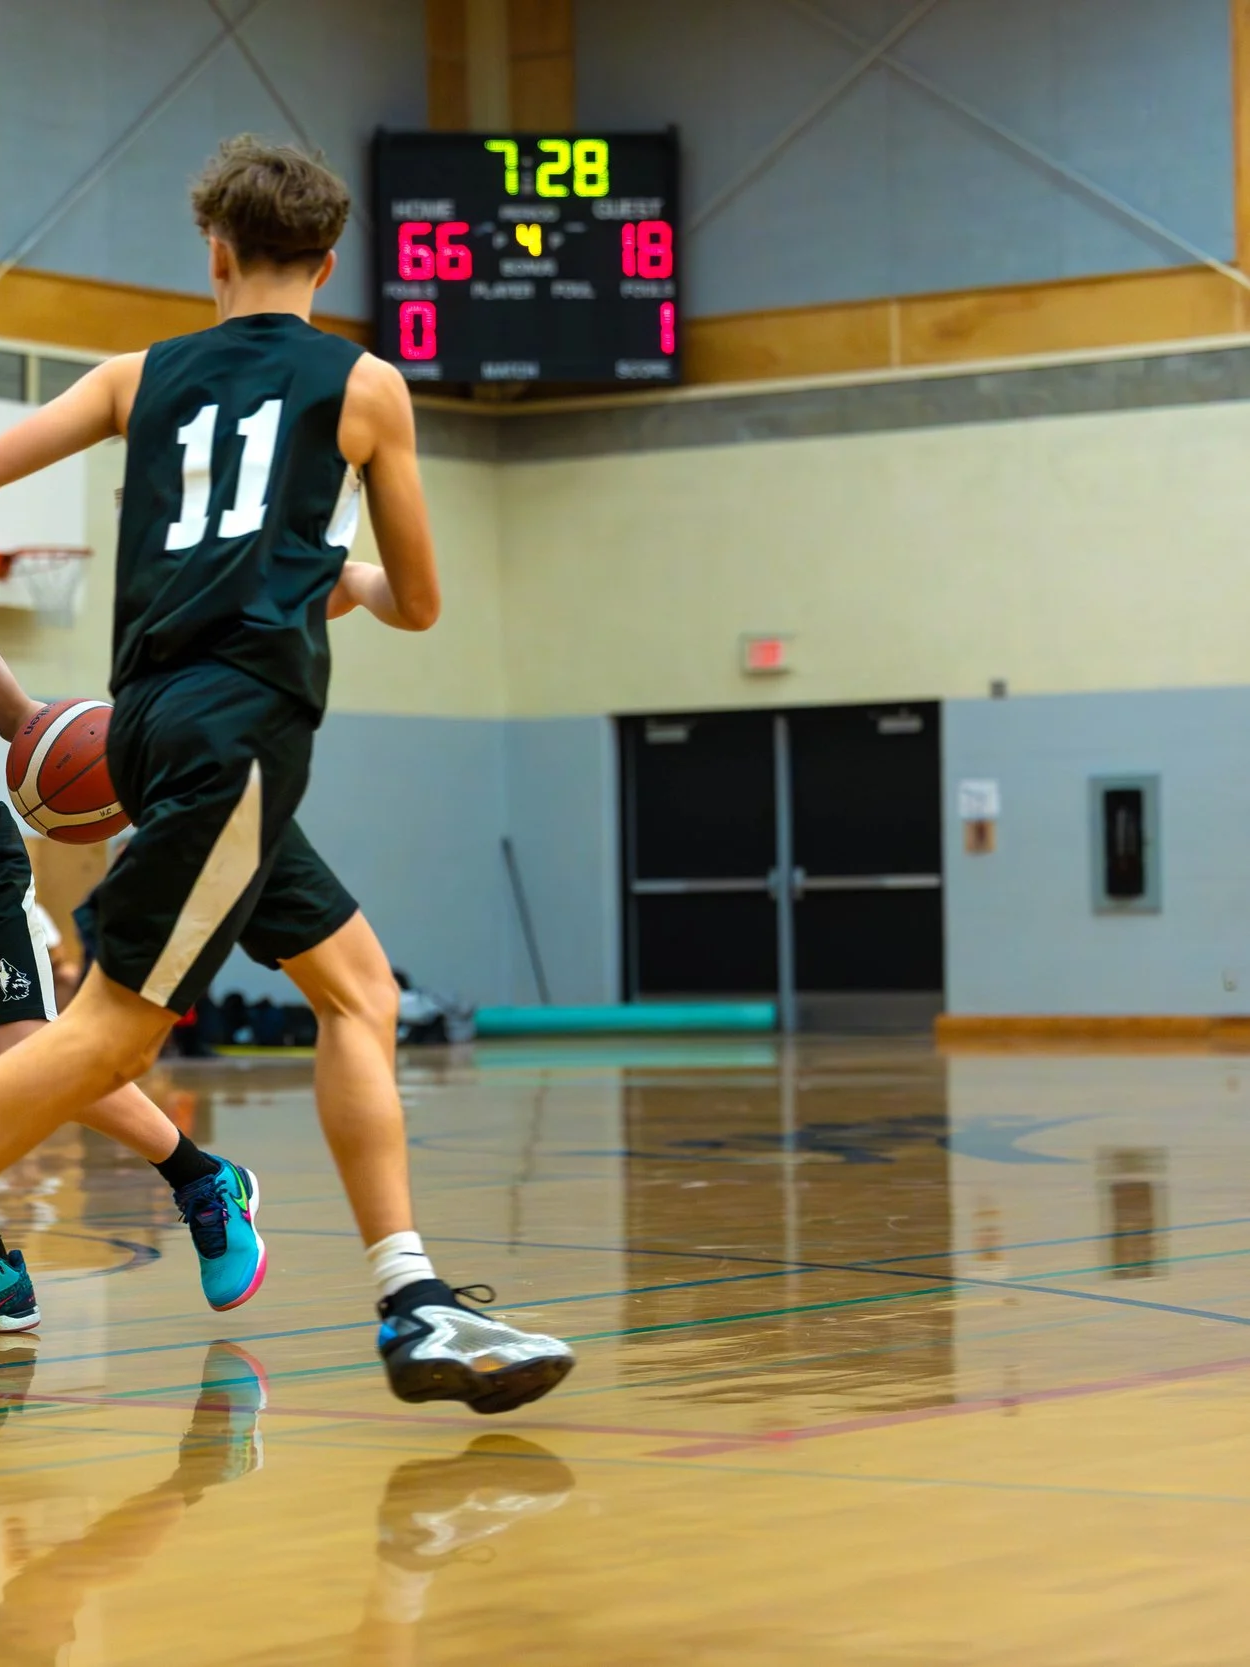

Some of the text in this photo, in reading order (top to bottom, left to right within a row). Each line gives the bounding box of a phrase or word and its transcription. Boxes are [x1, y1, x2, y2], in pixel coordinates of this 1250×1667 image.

[398, 221, 473, 281] 66
[516, 223, 542, 257] 4
[621, 220, 673, 279] 18
[400, 301, 437, 361] 0
[660, 301, 675, 355] 1
[165, 399, 283, 551] 11
